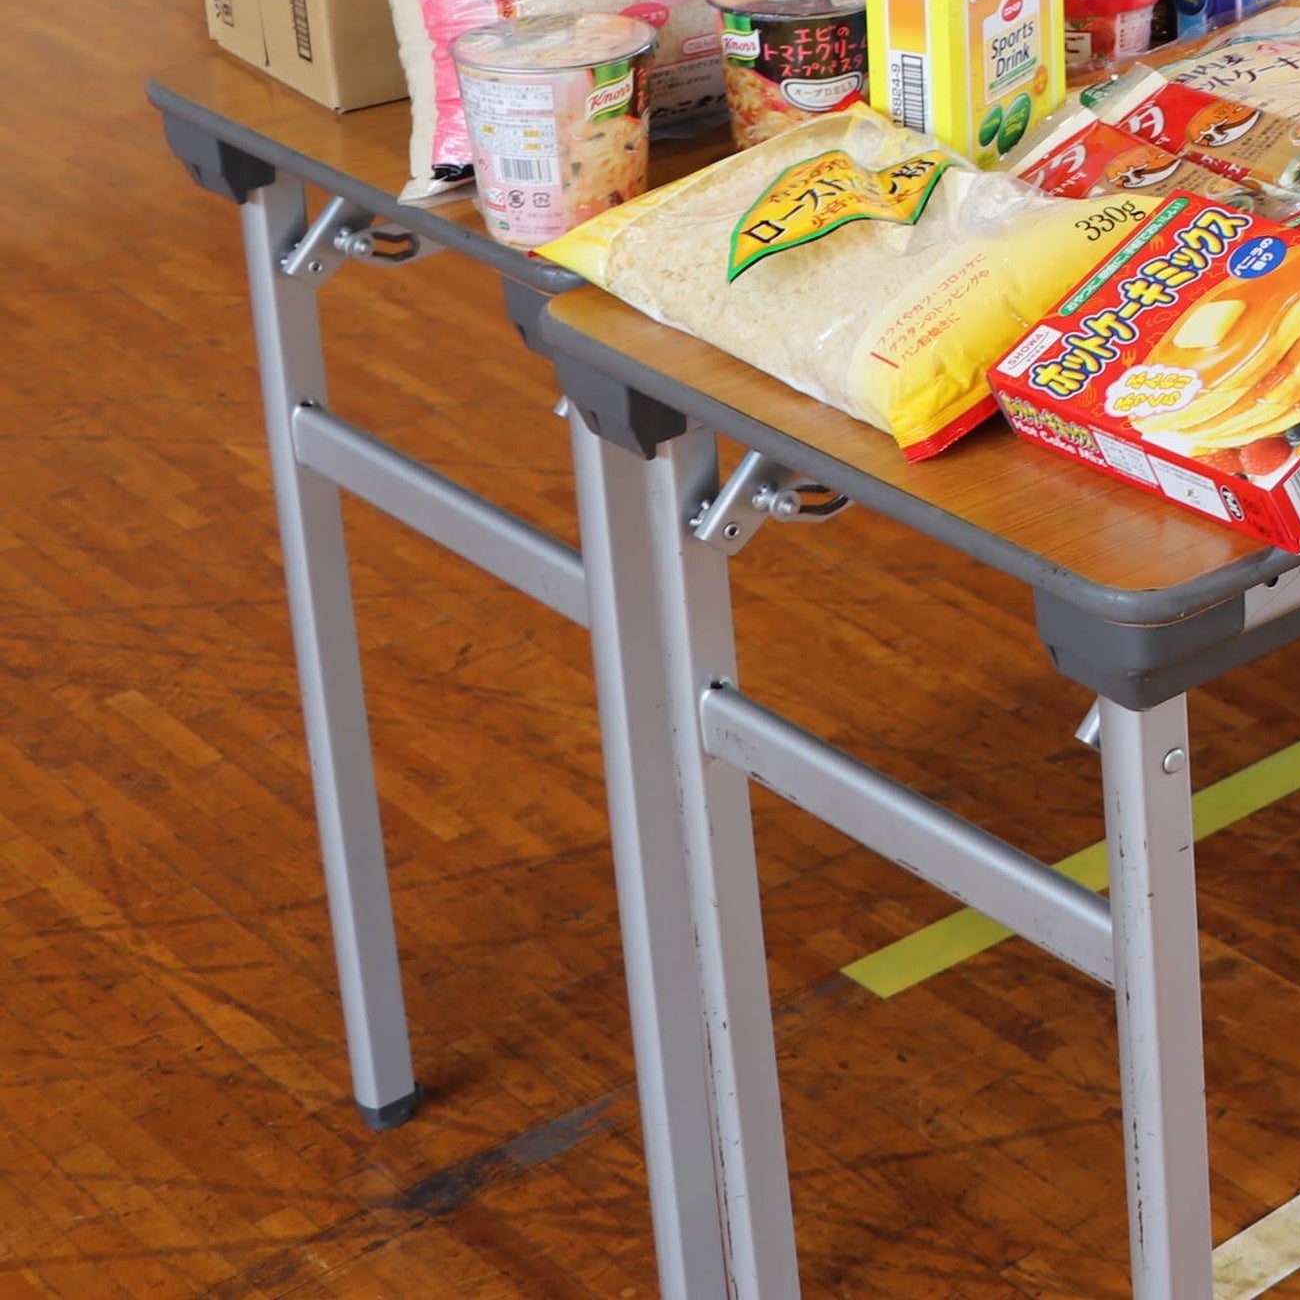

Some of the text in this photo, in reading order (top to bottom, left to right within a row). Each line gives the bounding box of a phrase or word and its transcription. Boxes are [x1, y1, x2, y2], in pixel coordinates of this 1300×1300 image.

[763, 36, 867, 62] トマトクリー
[794, 25, 850, 45] エビの
[991, 20, 1034, 59] Sports
[995, 43, 1032, 78] Drink
[589, 82, 632, 112] Knorr
[1075, 199, 1147, 242] 330g
[1031, 208, 1251, 399] ホットケーキミックス
[1007, 332, 1045, 367] SHOWA
